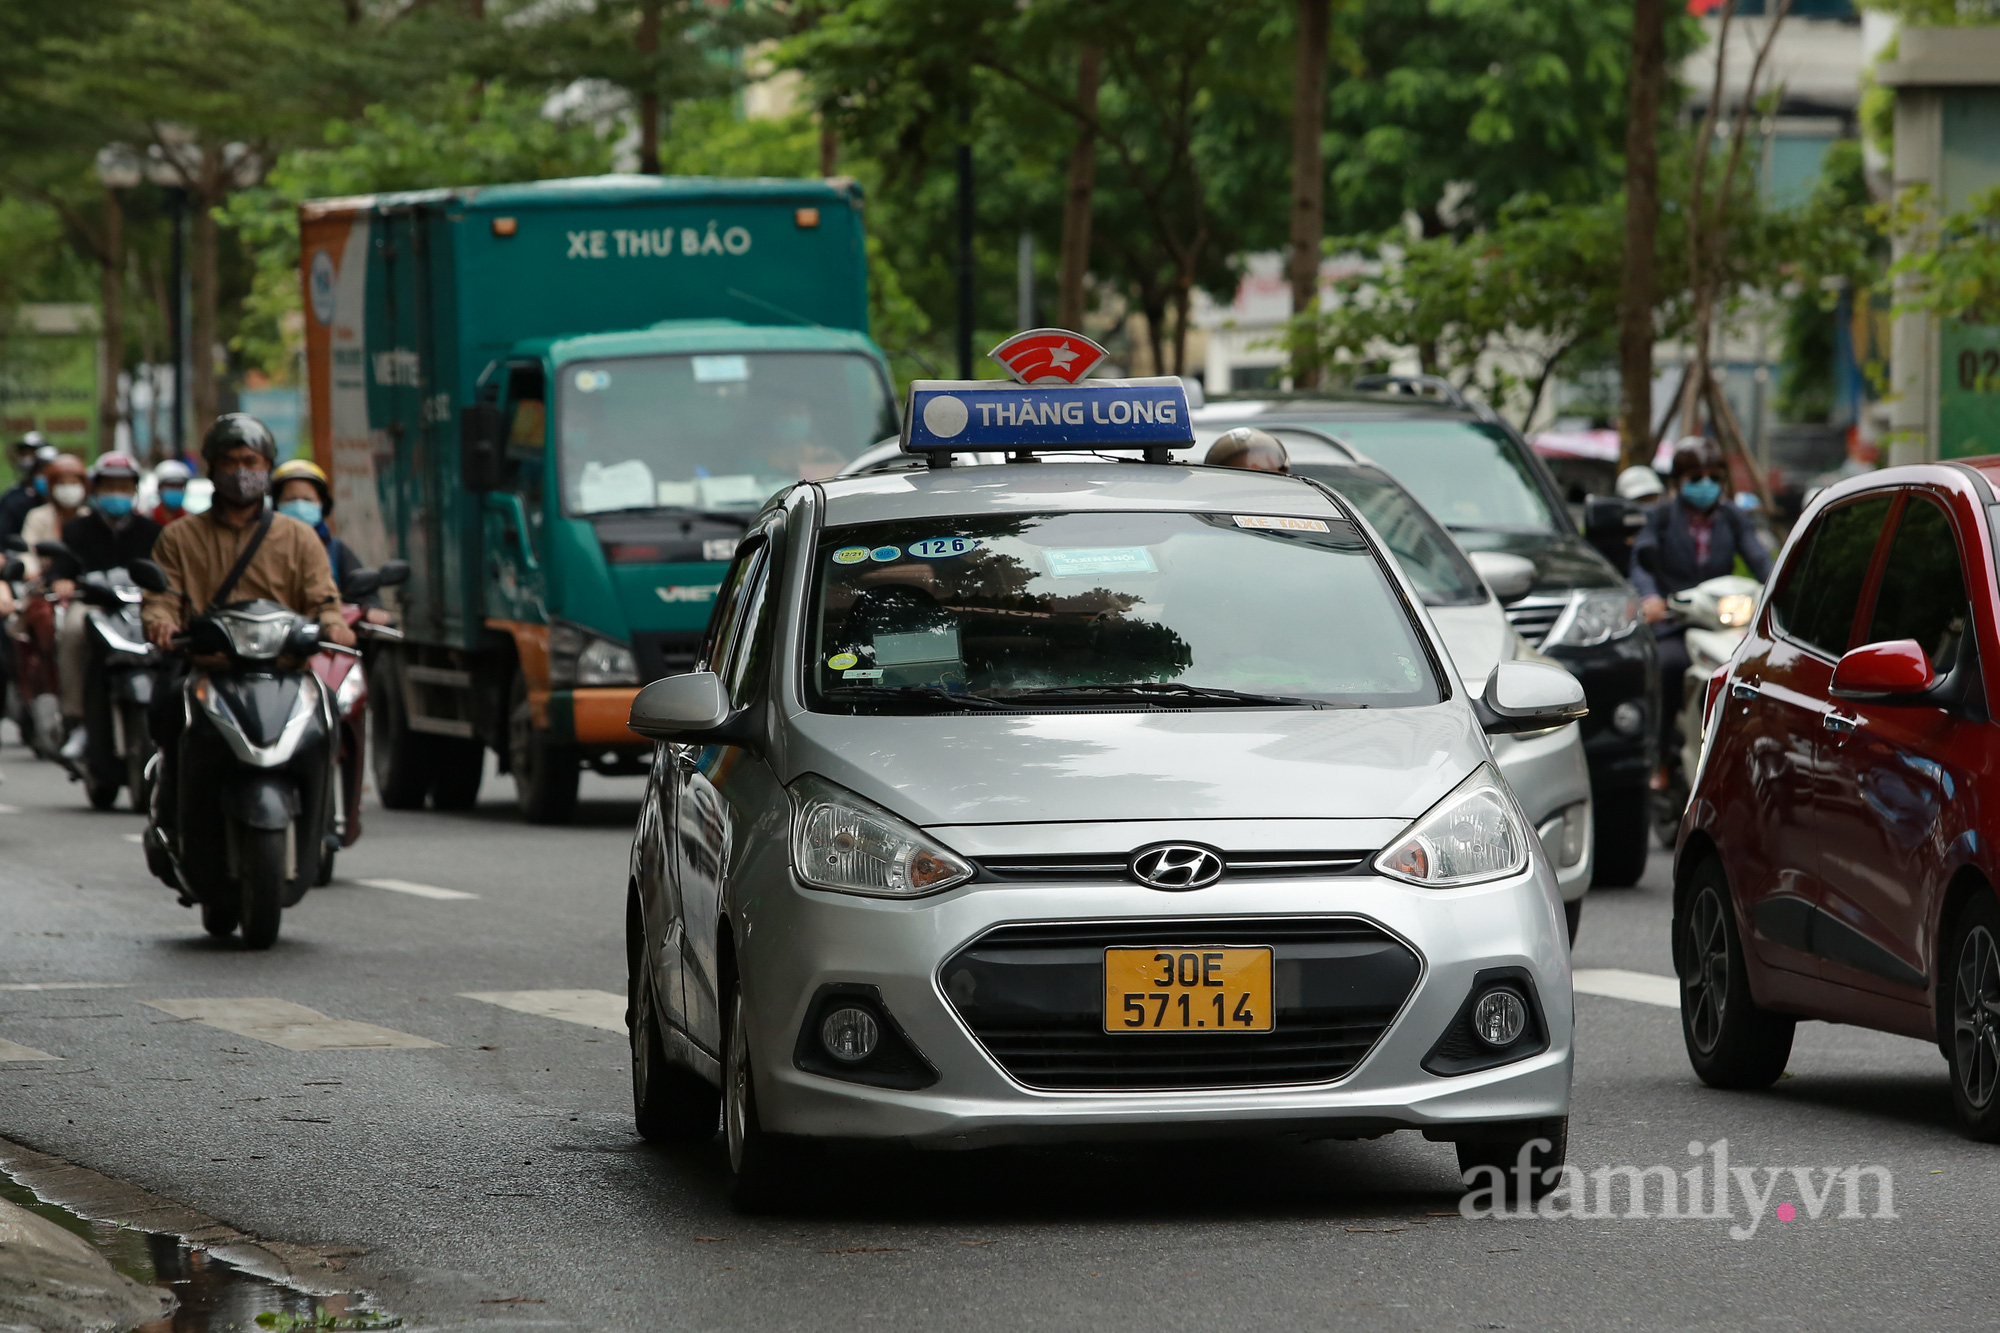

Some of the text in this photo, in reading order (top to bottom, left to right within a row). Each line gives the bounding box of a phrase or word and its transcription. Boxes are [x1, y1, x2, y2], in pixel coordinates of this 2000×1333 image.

[566, 218, 752, 259] XE THƯ BÁO
[975, 398, 1177, 427] THĂNG LONG
[1238, 516, 1324, 531] XE TAXI
[919, 539, 965, 555] 126
[1154, 952, 1224, 987] 30E
[1123, 992, 1254, 1027] 571.14
